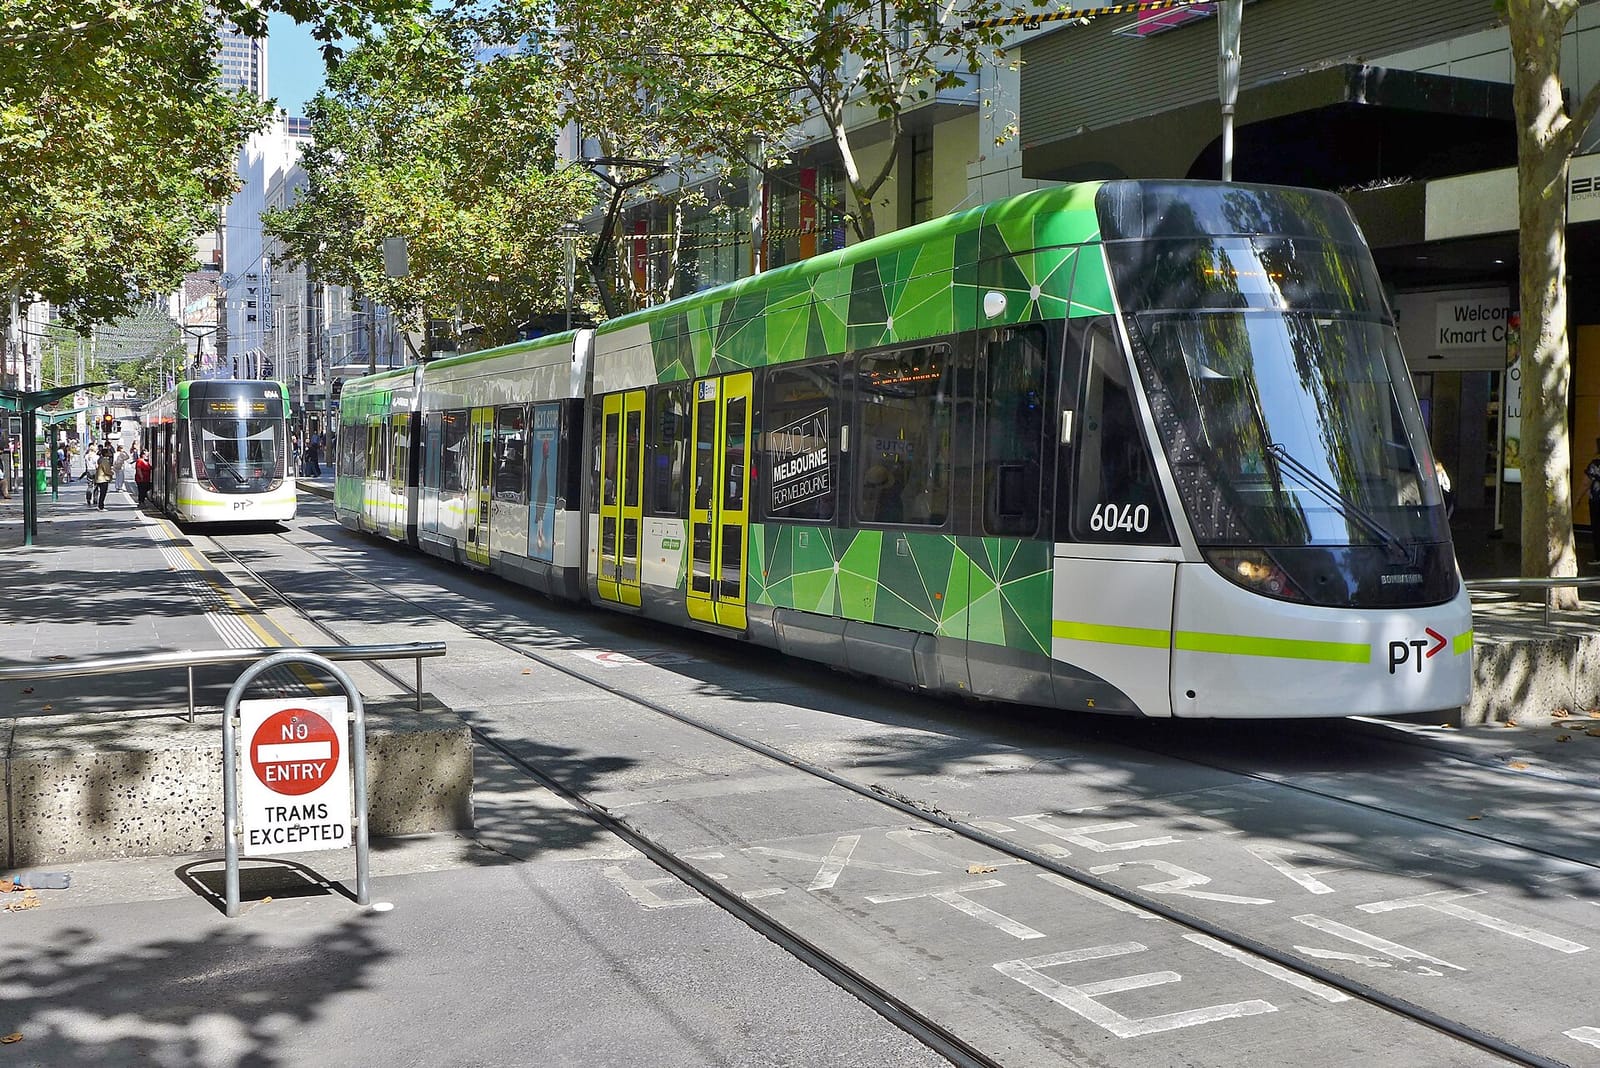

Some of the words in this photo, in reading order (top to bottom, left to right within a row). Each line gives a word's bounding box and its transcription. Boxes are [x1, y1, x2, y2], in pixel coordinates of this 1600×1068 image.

[1440, 326, 1487, 344] Kmart
[1492, 325, 1507, 342] C
[773, 420, 811, 464] MADE
[813, 413, 827, 448] IN
[773, 447, 827, 483] MELBOURNE
[774, 487, 788, 505] FOR
[787, 472, 828, 501] MELBOURNE
[1090, 503, 1149, 533] 6040
[1388, 640, 1428, 675] PT
[281, 723, 309, 741] NO
[265, 762, 327, 782] ENTRY
[264, 803, 328, 823] TRAMS
[250, 823, 344, 846] EXCEPTED
